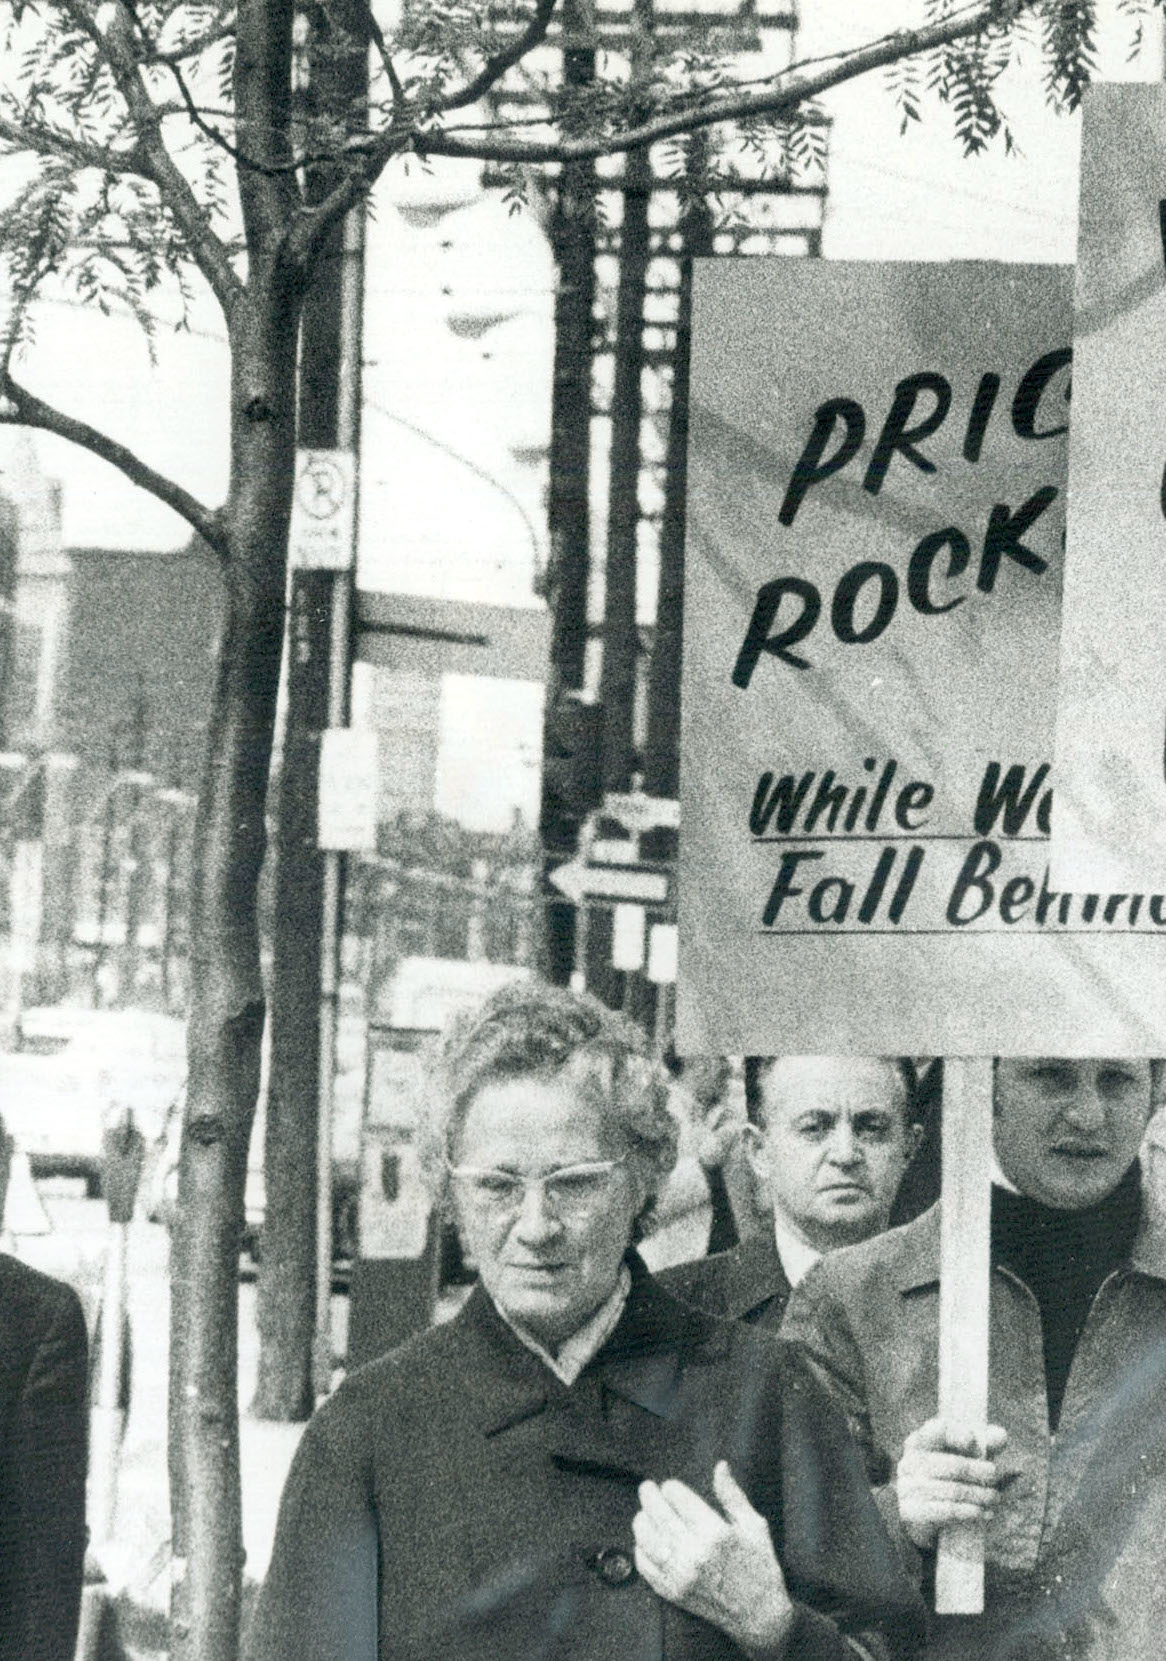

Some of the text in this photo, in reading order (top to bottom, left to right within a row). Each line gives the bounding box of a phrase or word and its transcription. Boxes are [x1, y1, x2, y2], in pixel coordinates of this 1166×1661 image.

[732, 485, 1066, 689] ROCK
[748, 758, 935, 836] While
[761, 845, 926, 927] Fall
